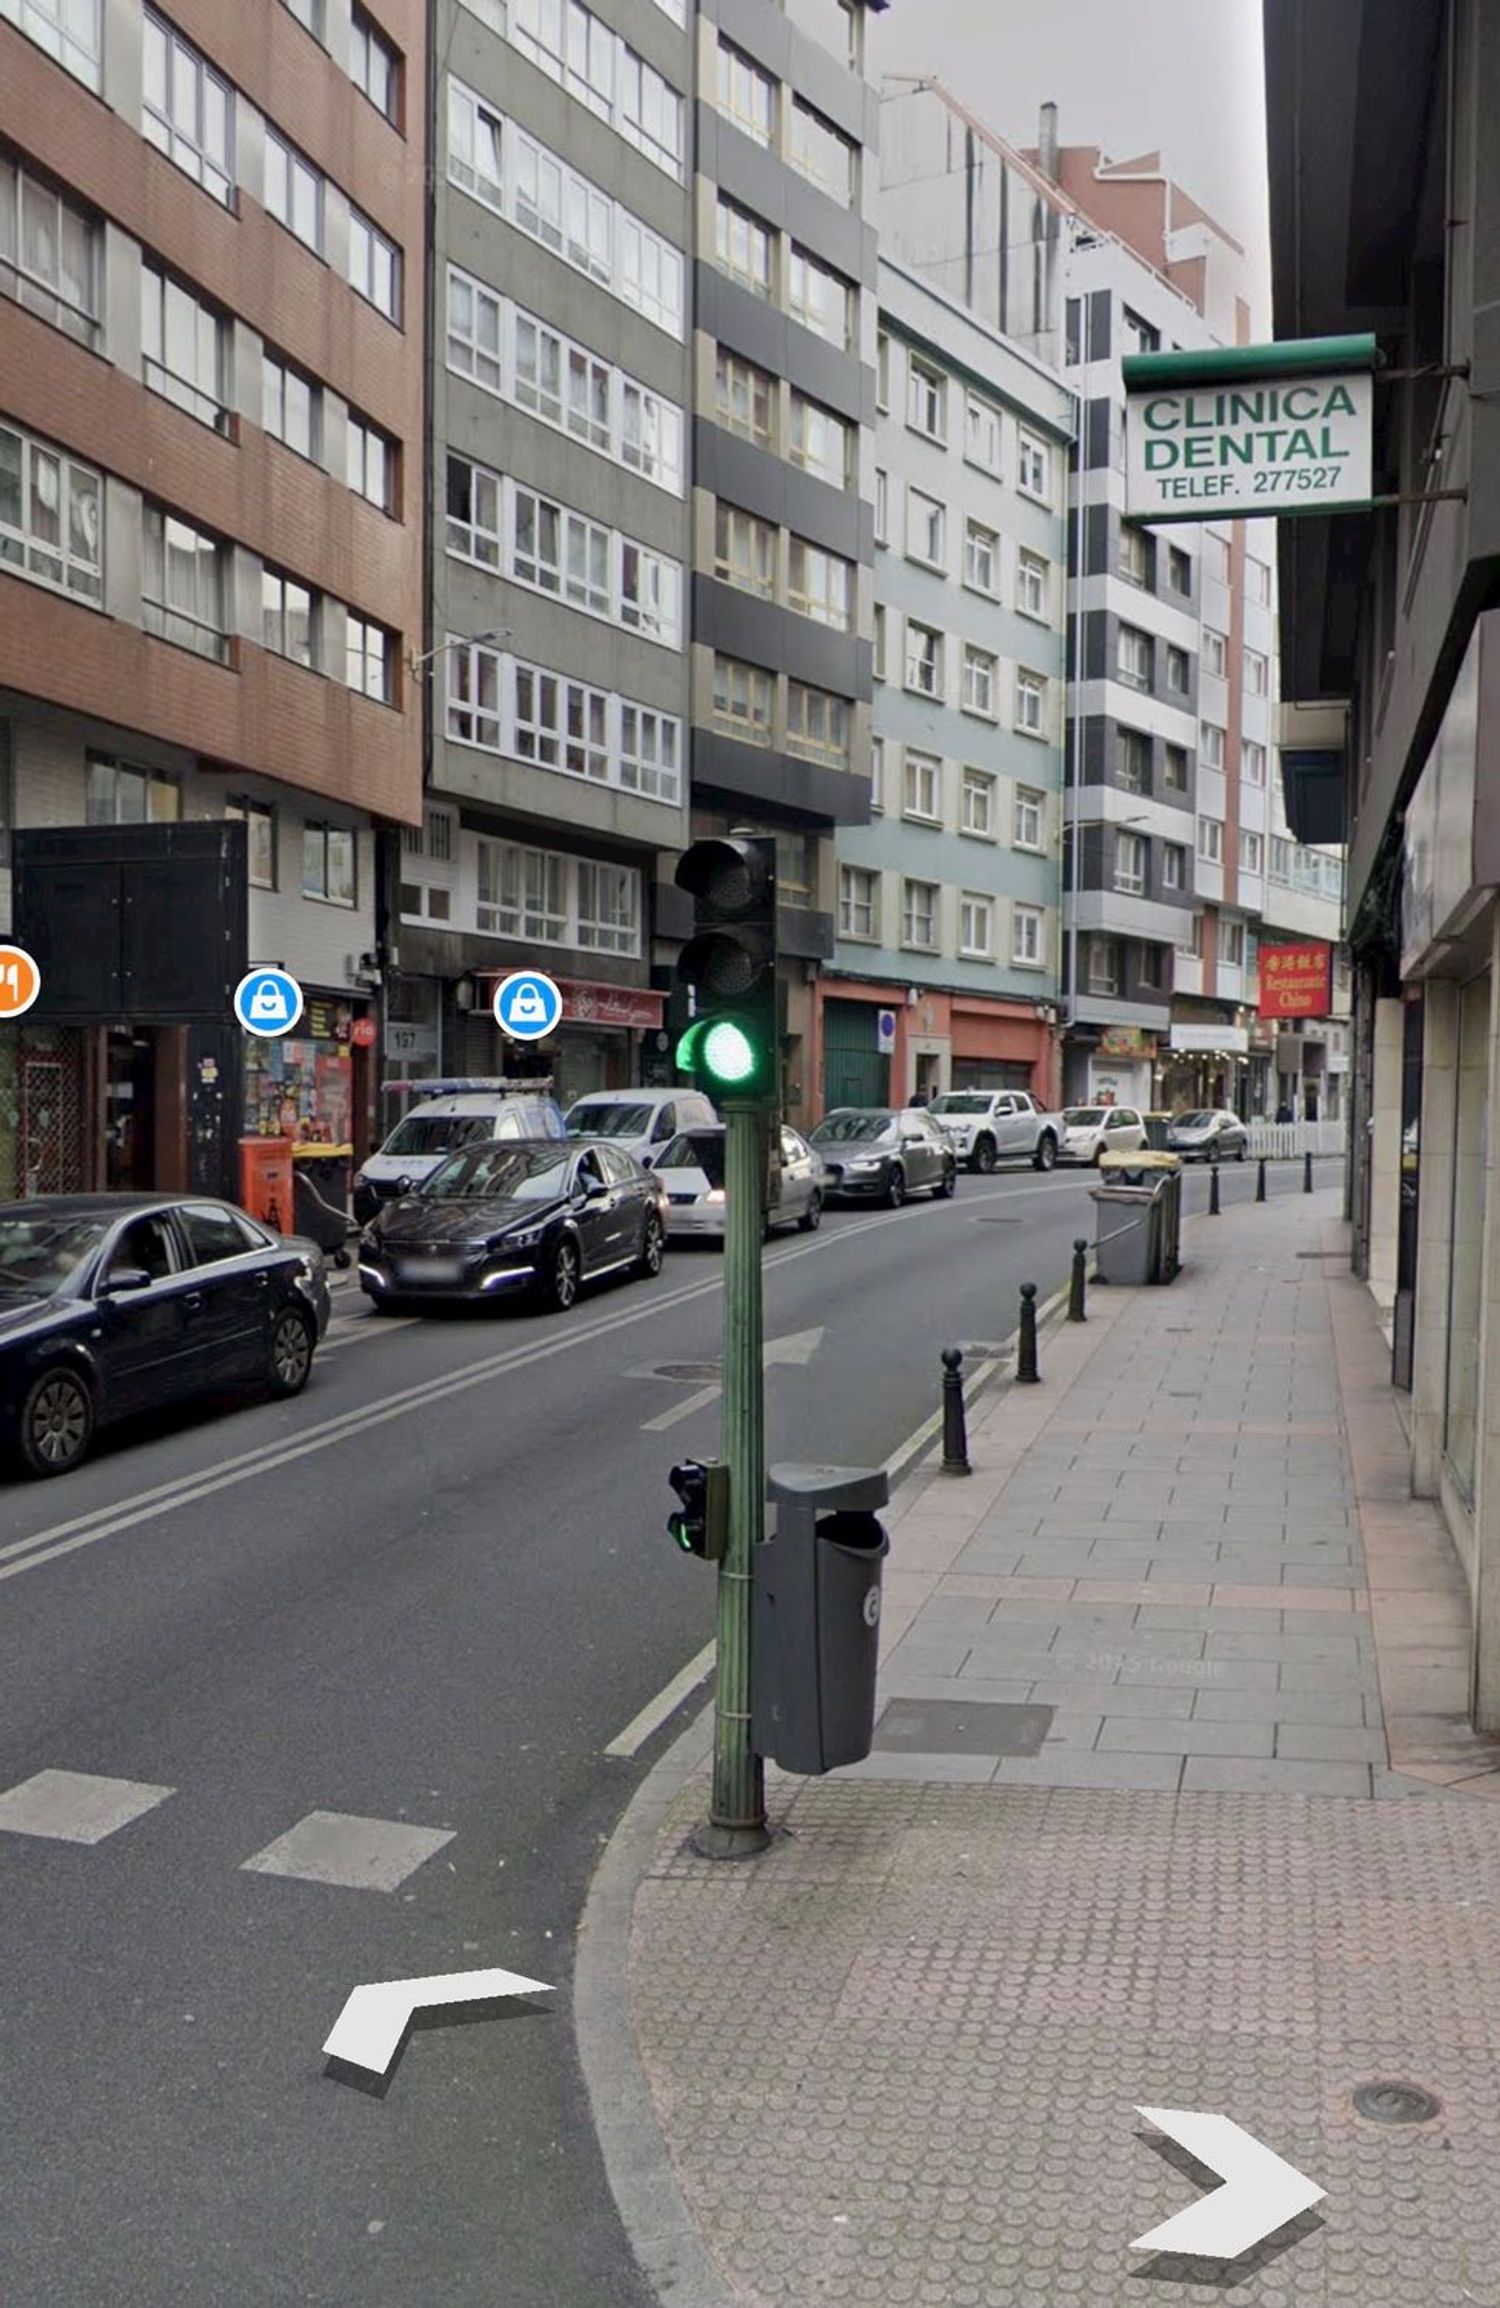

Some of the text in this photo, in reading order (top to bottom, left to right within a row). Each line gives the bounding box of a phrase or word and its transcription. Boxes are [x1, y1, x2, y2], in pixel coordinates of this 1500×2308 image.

[1143, 385, 1356, 431] CLINICA
[1144, 427, 1349, 471] DENTAL
[1157, 467, 1342, 499] TELEF. 277527
